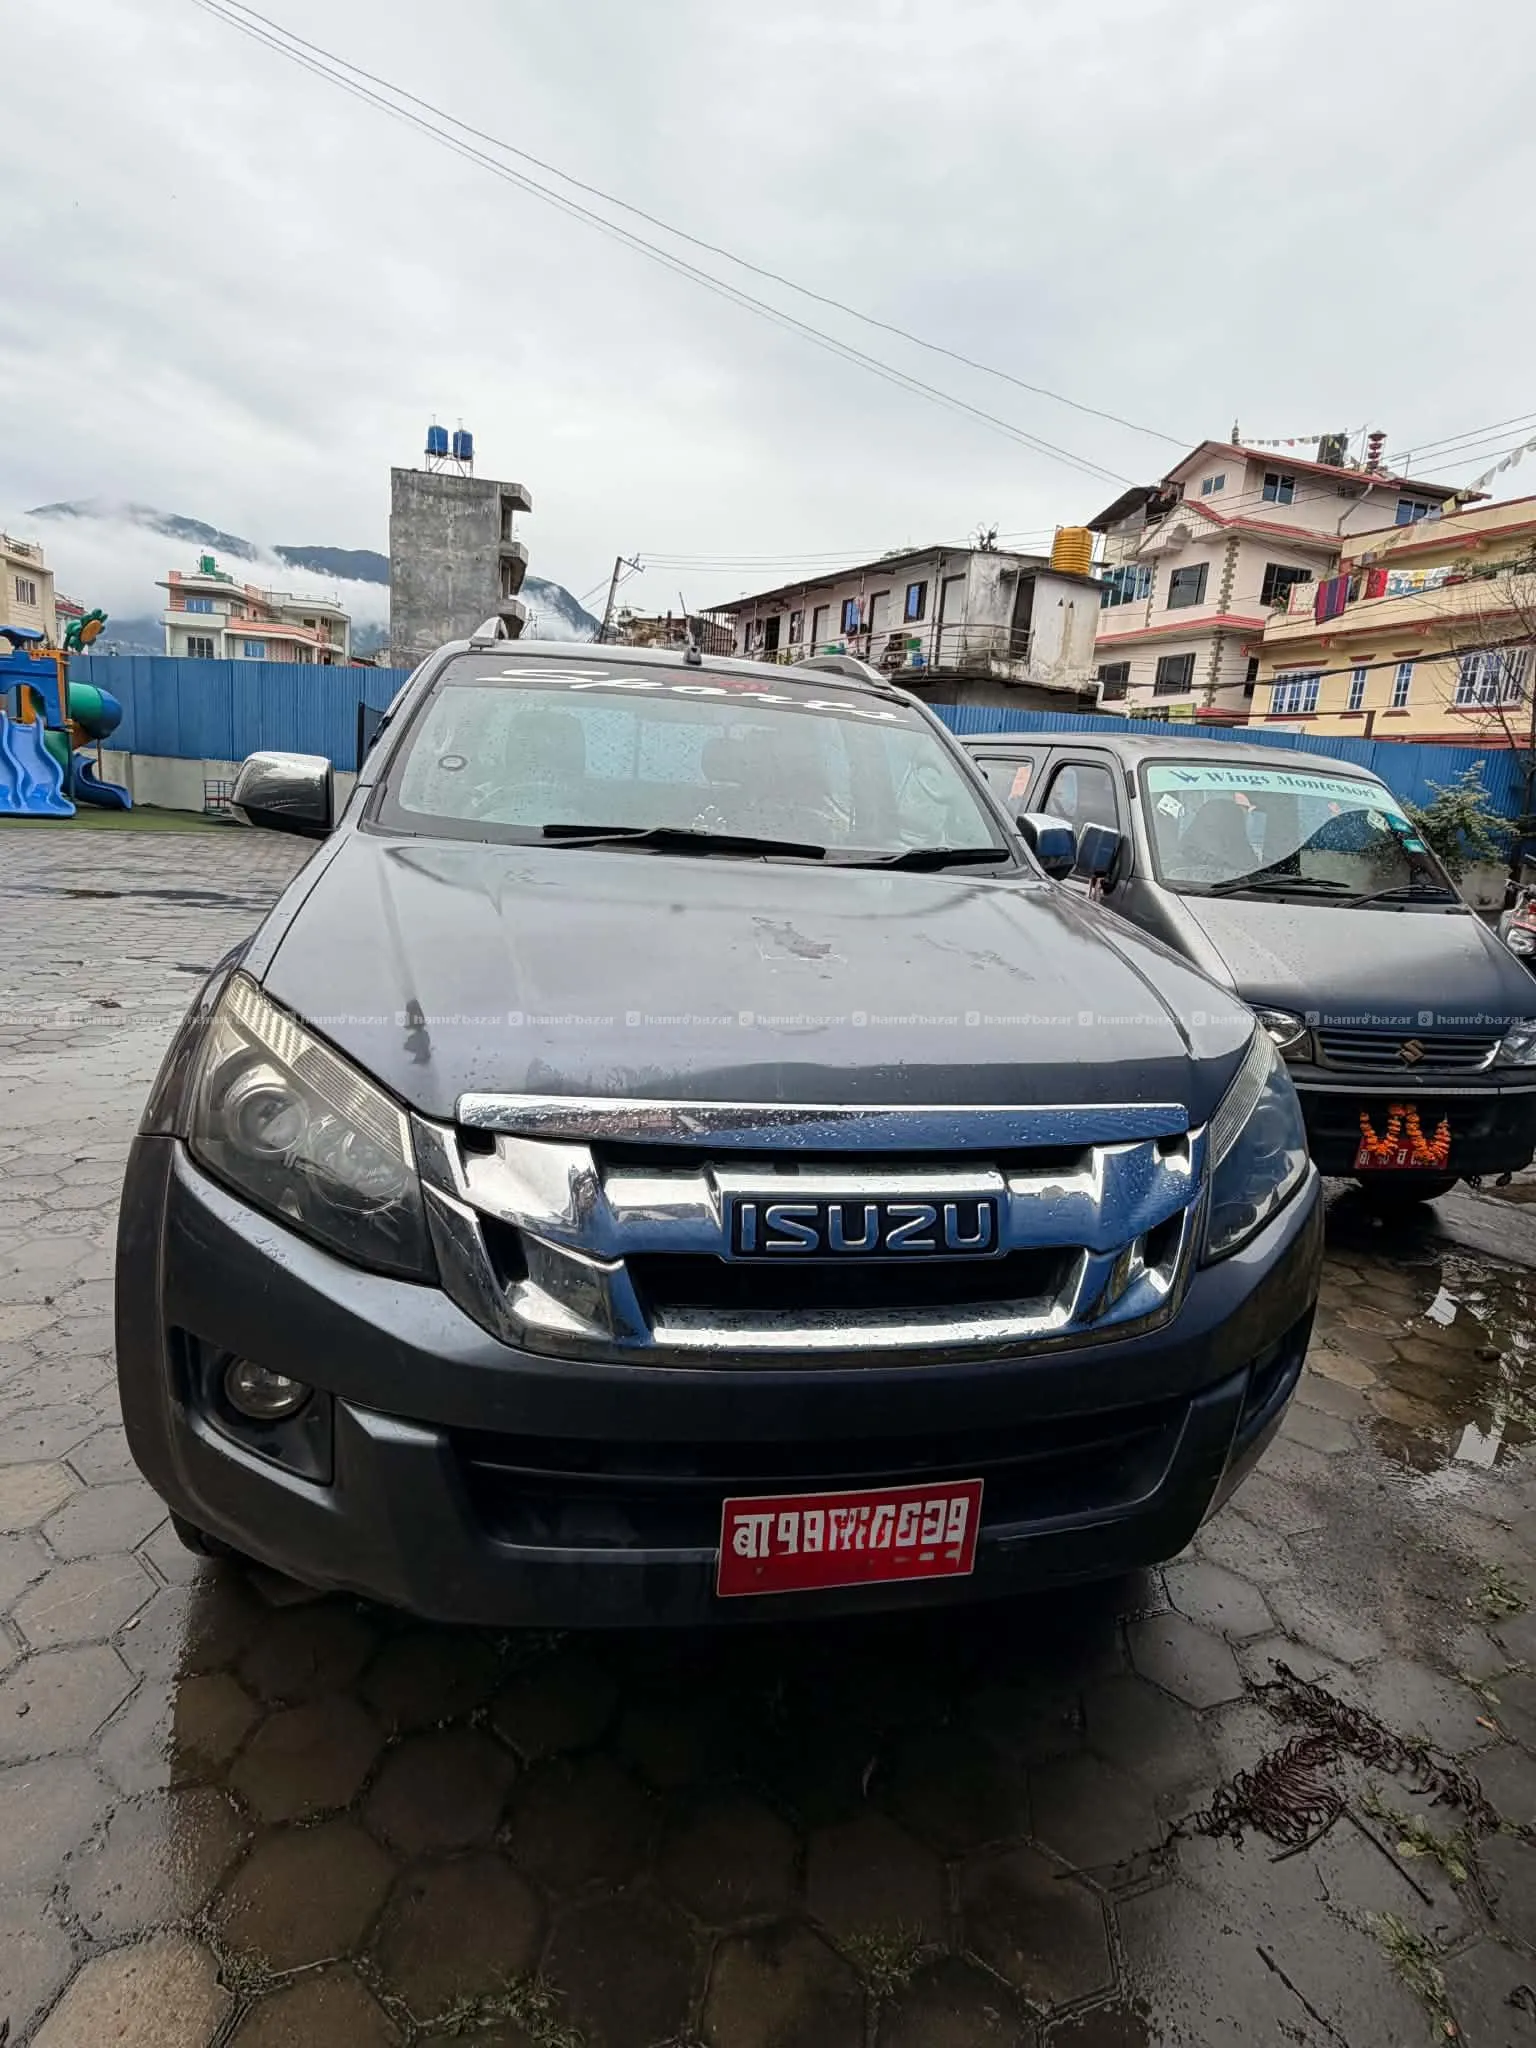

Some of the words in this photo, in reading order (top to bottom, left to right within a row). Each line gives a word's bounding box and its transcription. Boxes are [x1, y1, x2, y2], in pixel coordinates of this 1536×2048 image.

[1205, 771, 1270, 785] Wings
[1277, 774, 1376, 799] Montessori
[741, 1203, 990, 1250] ISUZU
